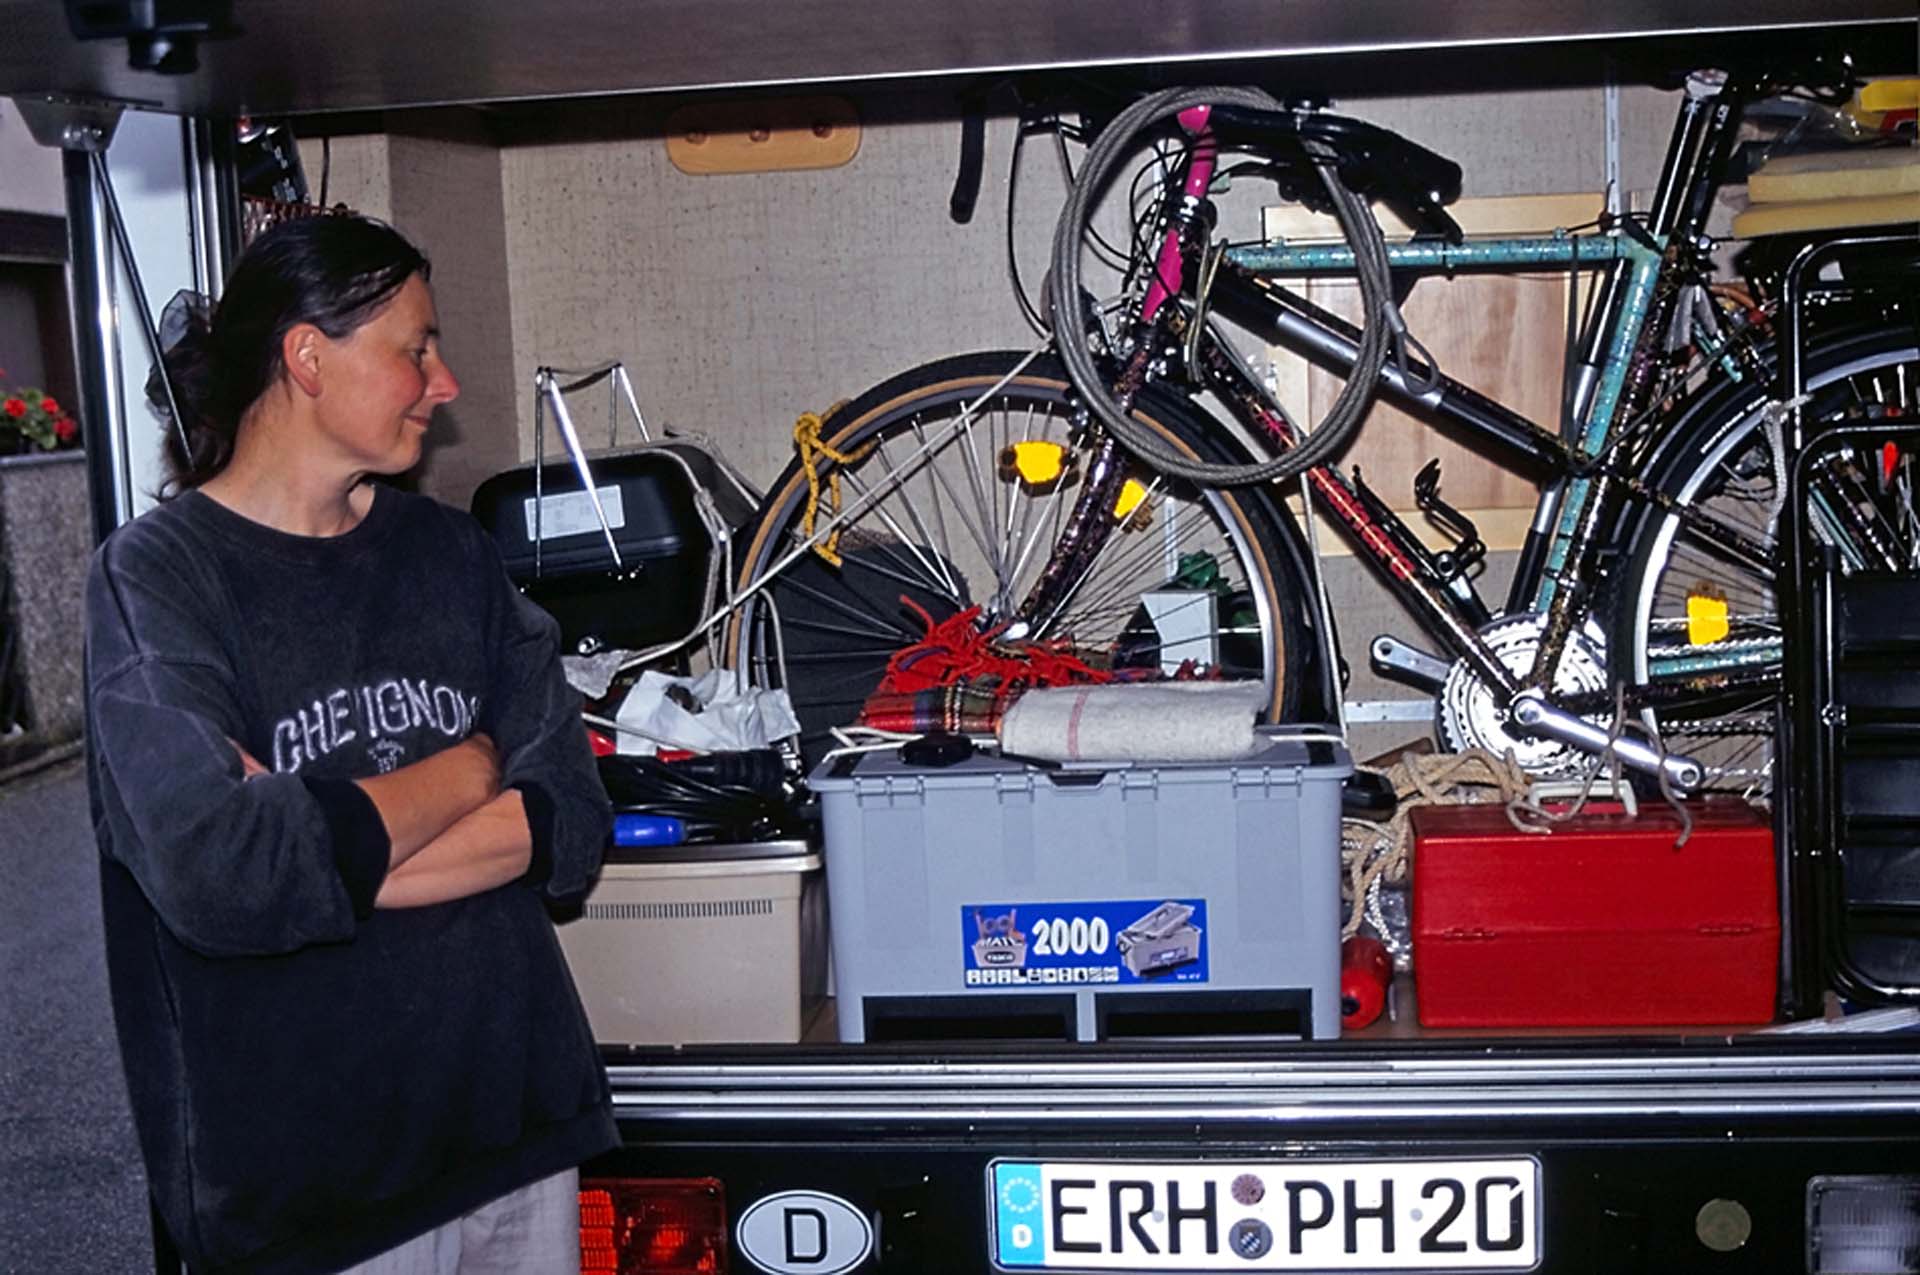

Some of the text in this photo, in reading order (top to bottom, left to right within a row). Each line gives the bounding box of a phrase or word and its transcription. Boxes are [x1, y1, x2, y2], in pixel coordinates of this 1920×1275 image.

[1032, 917, 1109, 956] 2000
[784, 1208, 827, 1264] D
[1012, 1223, 1033, 1249] D
[1051, 1176, 1525, 1255] ERH PH 20
